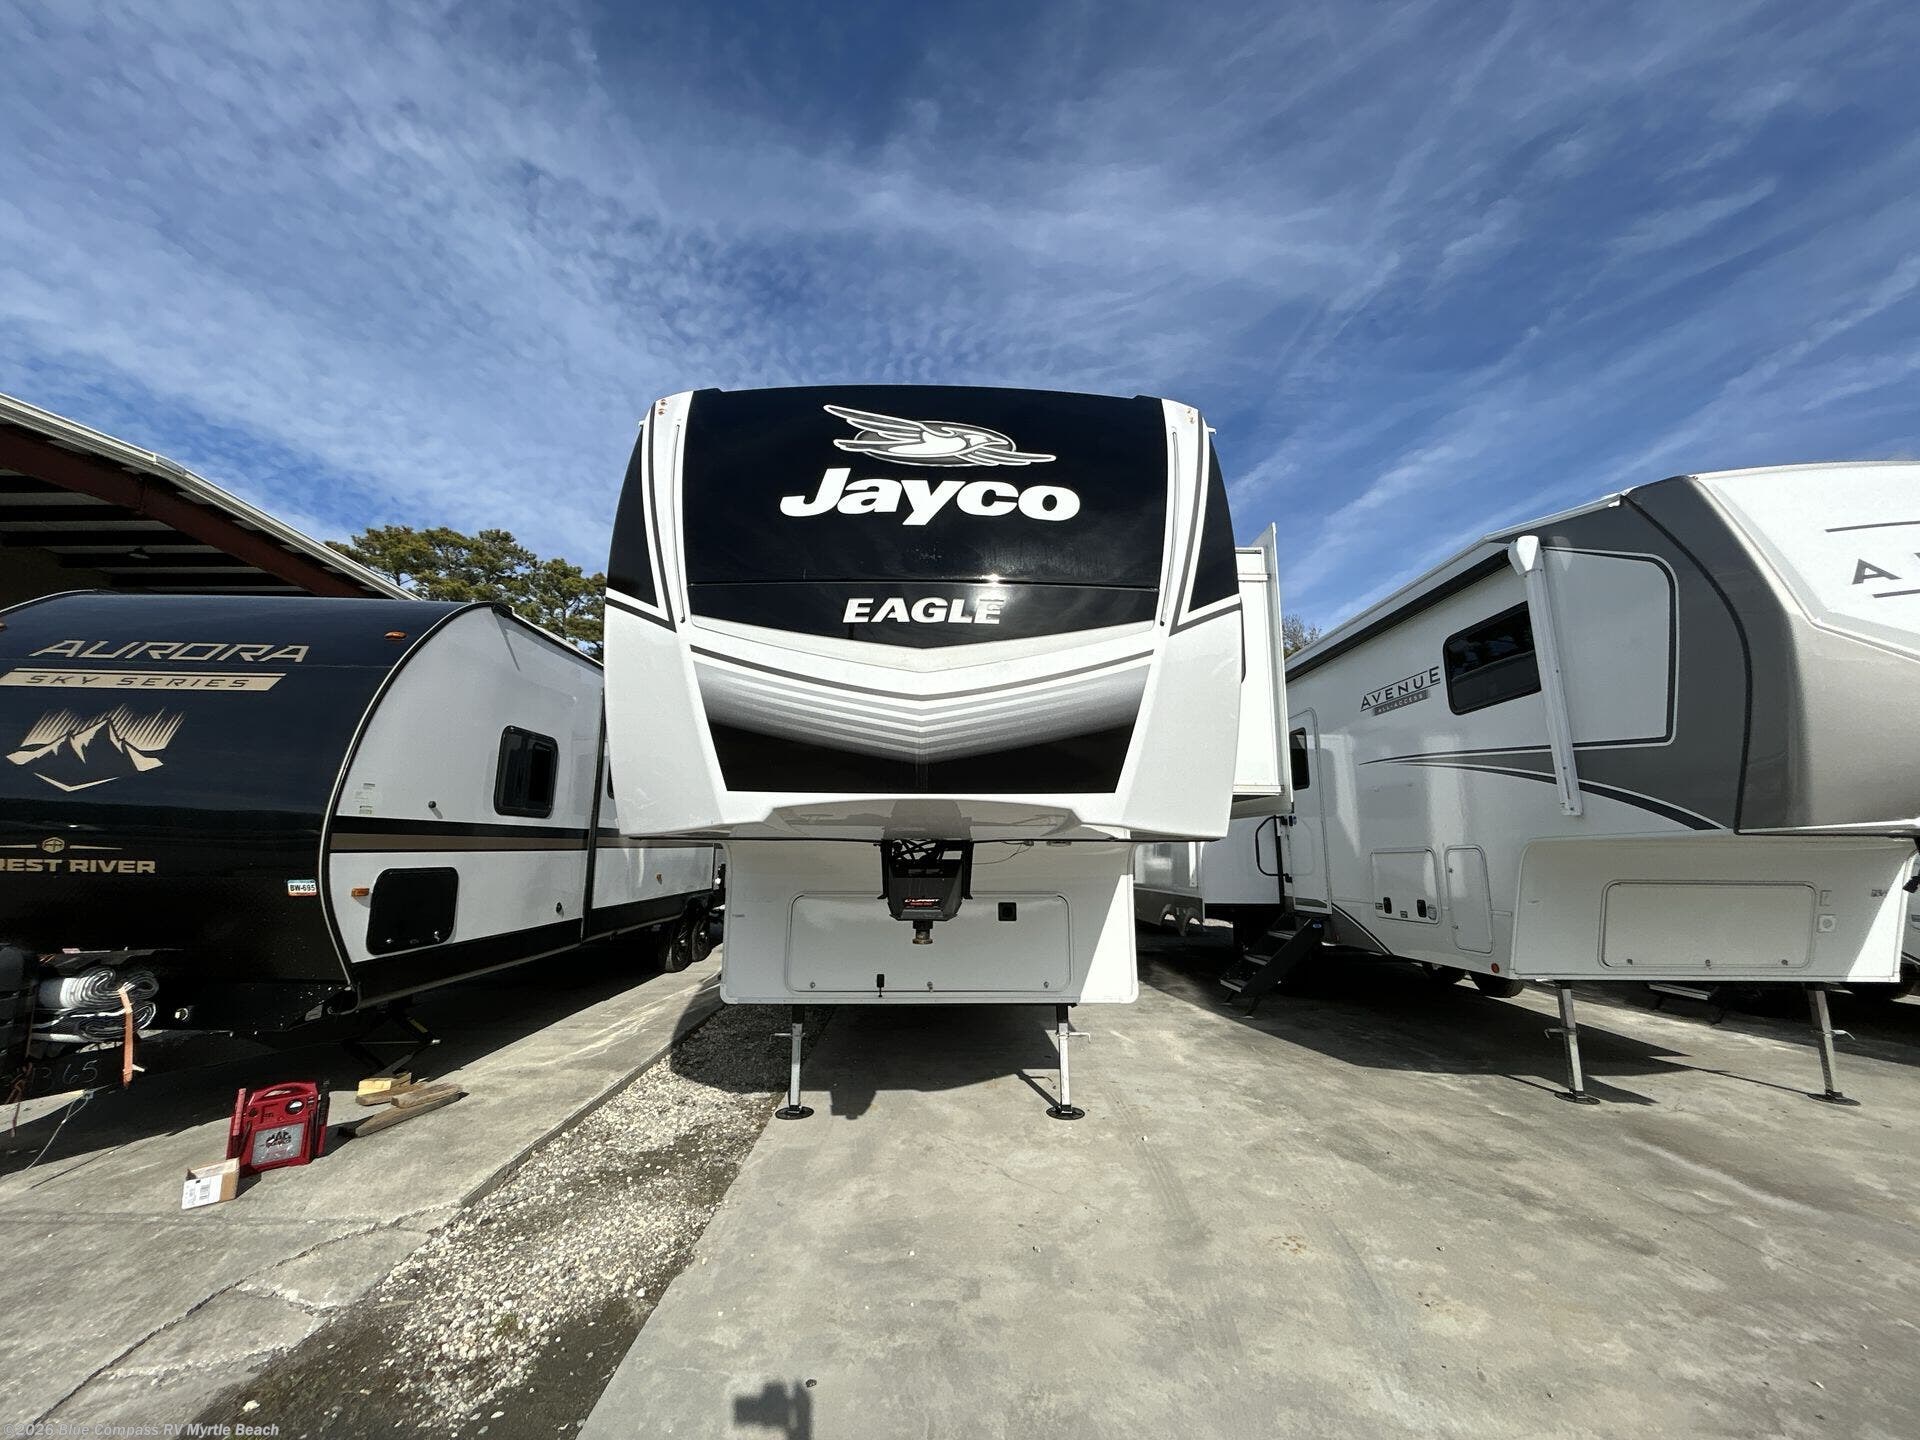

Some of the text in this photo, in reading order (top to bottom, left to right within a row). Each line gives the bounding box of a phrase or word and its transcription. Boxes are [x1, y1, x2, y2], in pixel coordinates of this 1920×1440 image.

[779, 467, 1081, 526] Jayco
[1852, 552, 1920, 585] A
[842, 597, 1004, 625] EAGLE
[28, 639, 310, 663] AURORA
[25, 675, 251, 688] SKY SERIES
[1360, 665, 1441, 710] AVENUE
[0, 858, 156, 873] EST RIVER
